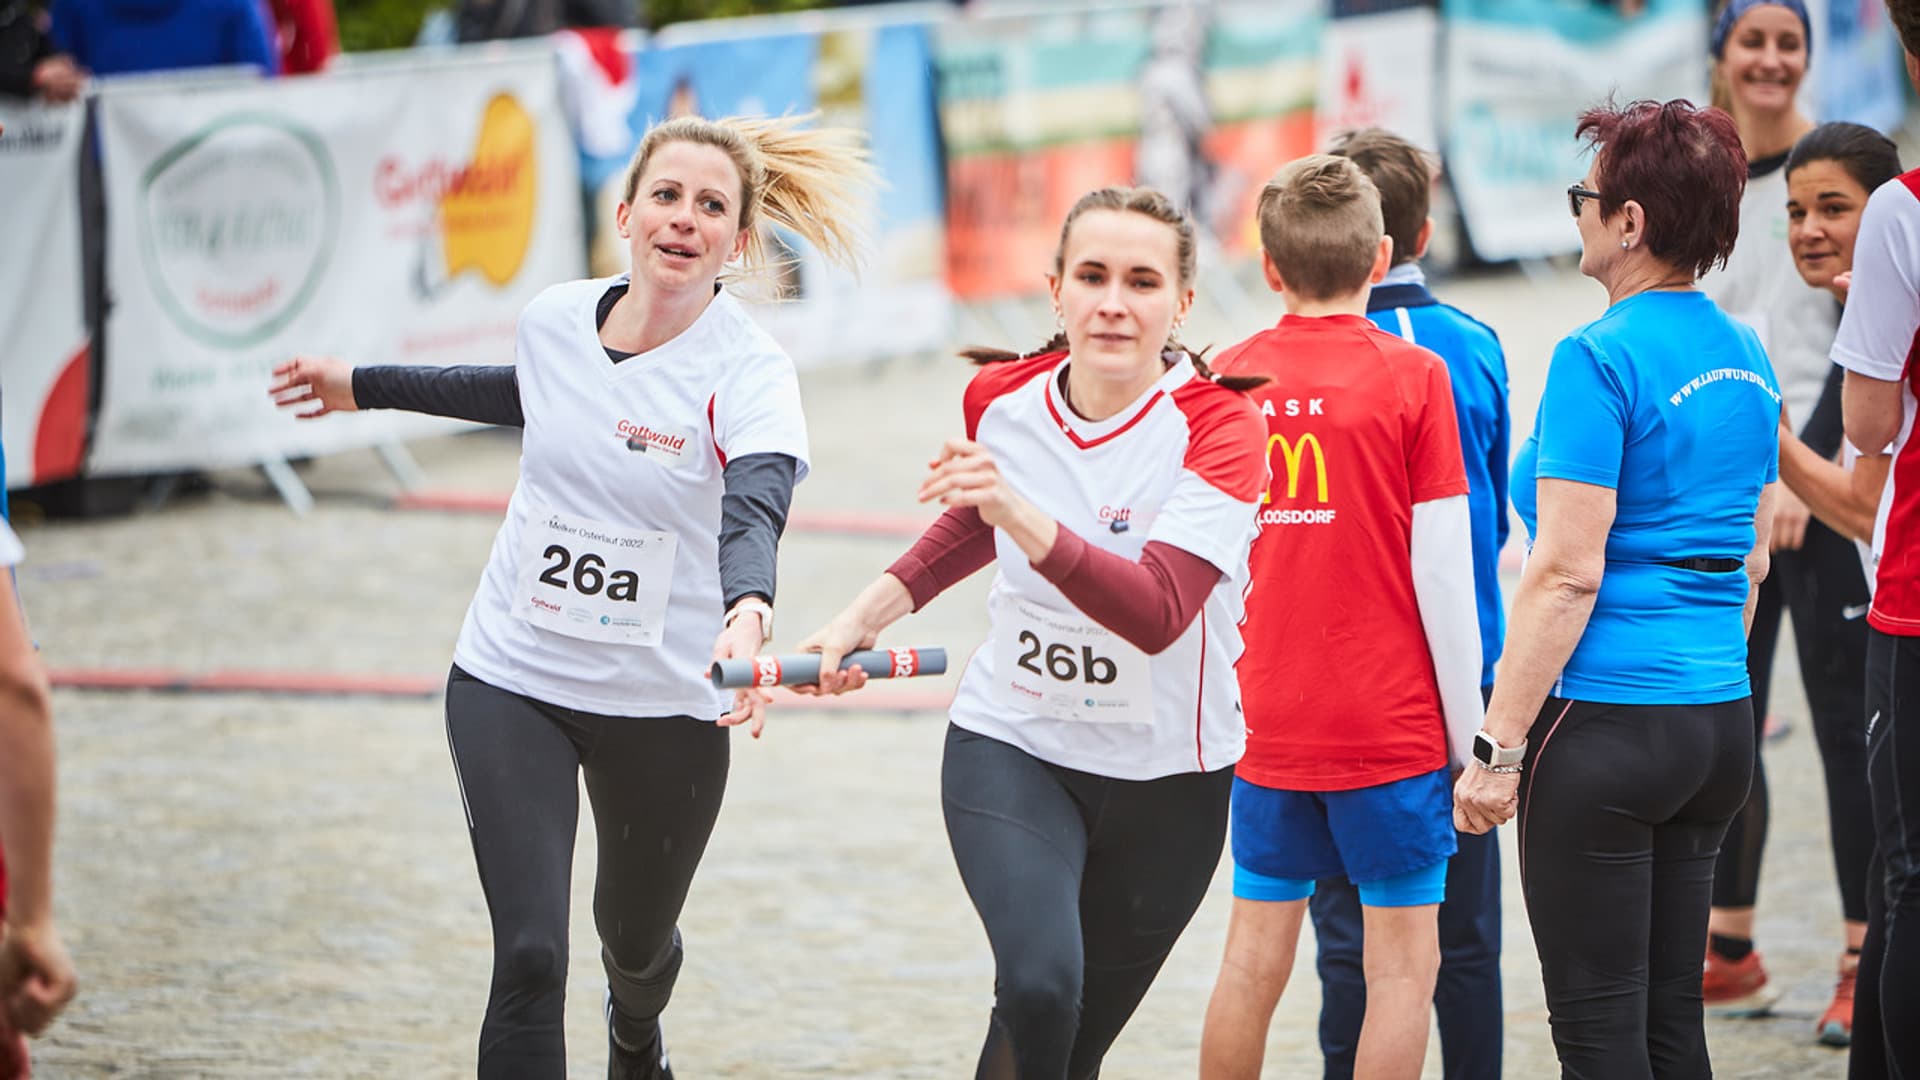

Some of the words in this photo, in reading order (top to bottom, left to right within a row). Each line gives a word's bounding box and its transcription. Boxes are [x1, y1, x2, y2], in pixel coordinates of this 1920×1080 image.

[616, 418, 686, 450] Gottwald
[538, 544, 640, 603] 26a
[1017, 629, 1118, 685] 26b
